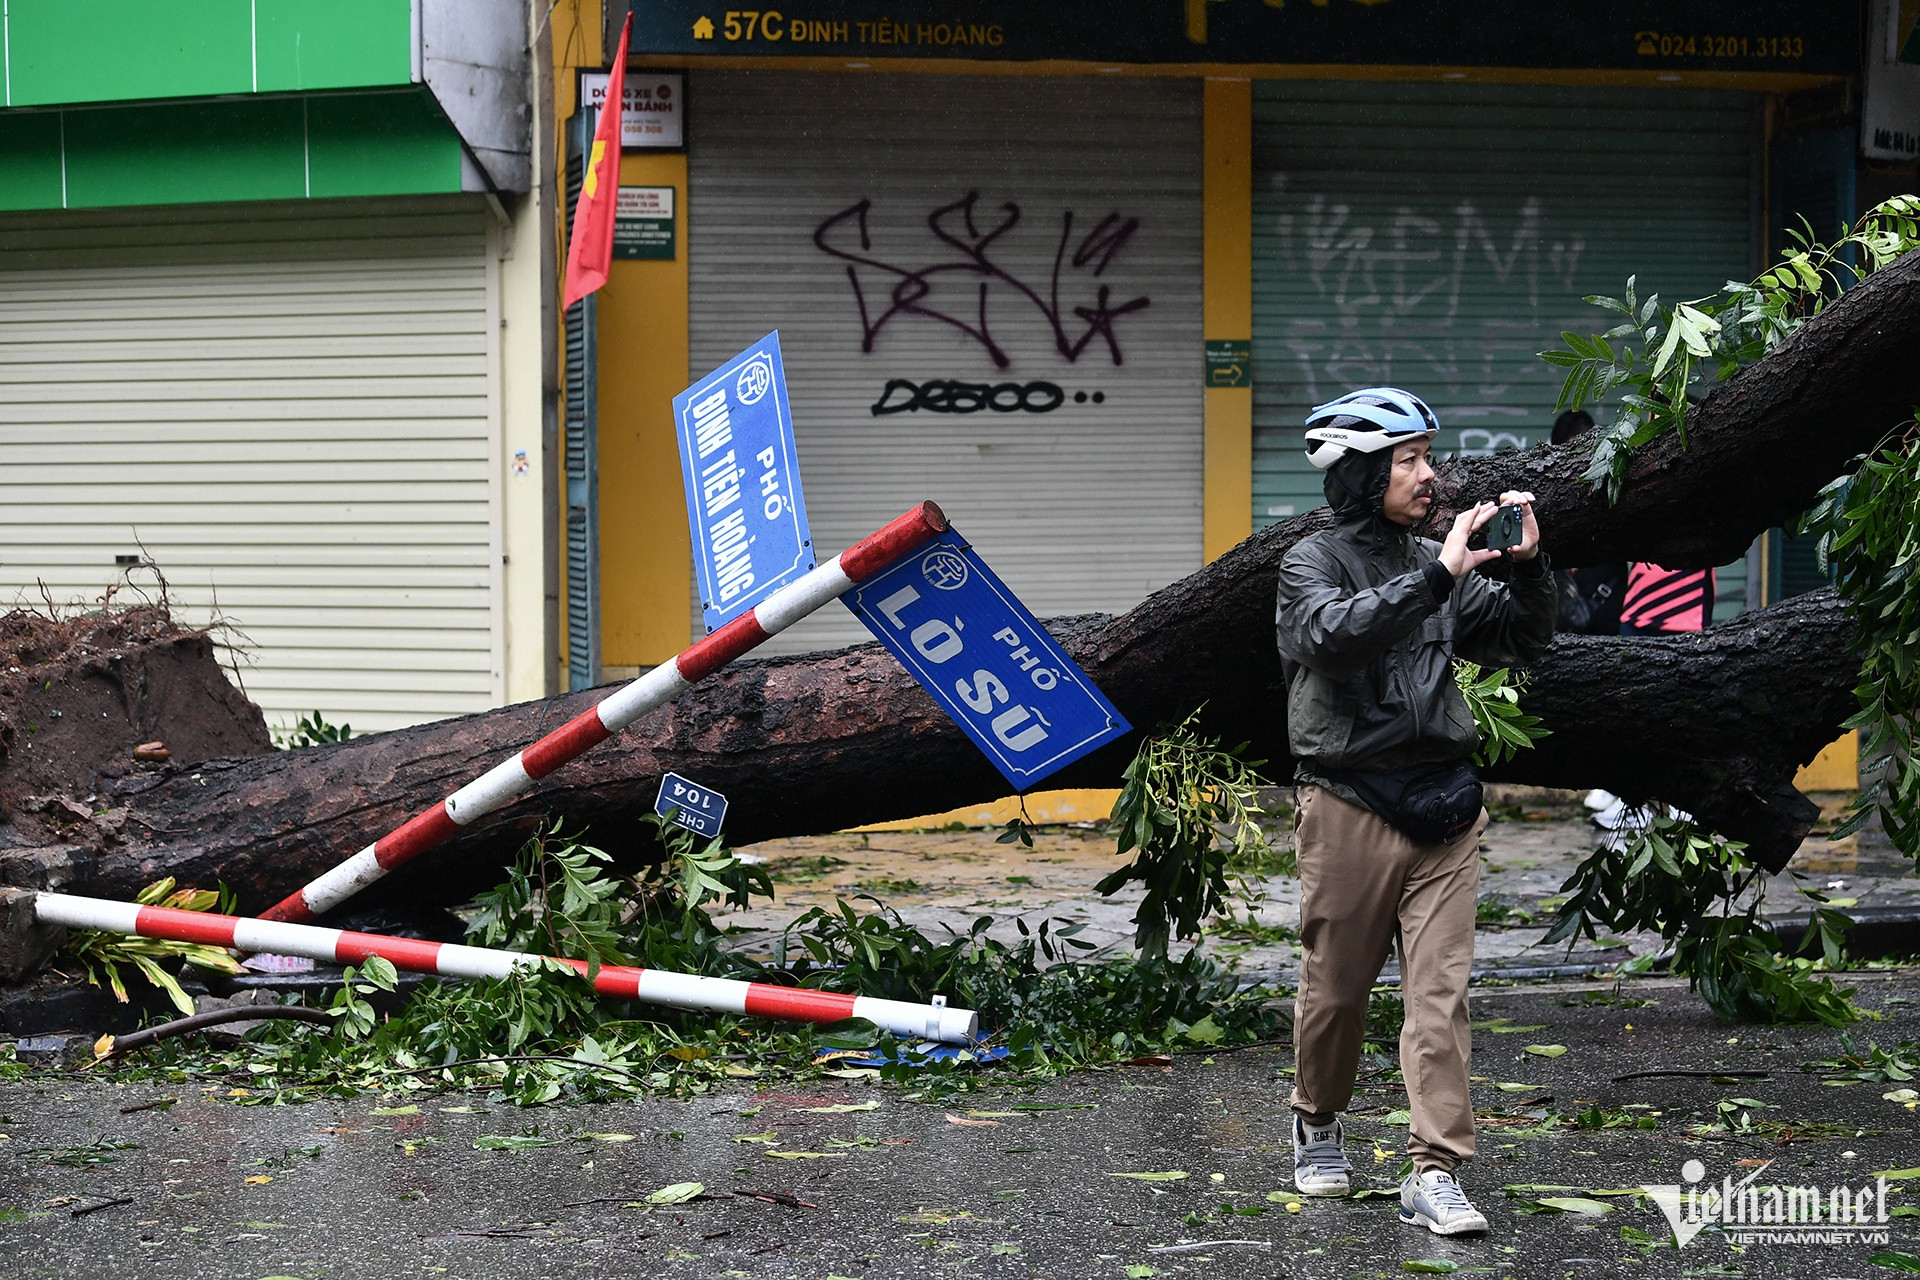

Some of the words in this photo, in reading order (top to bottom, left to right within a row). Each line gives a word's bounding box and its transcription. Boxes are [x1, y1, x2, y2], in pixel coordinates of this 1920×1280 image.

[724, 11, 783, 41] 57C
[790, 19, 848, 43] ĐINH
[857, 17, 909, 44] TIÊN
[916, 18, 1004, 46] HOÀNG
[1660, 35, 1803, 57] 024.3201.3133
[634, 100, 672, 112] BÁNH
[692, 388, 733, 459] ĐINH
[702, 448, 746, 518] TIÊN
[756, 446, 792, 520] PHỐ
[709, 507, 757, 602] HOÀNG
[876, 584, 965, 664] LÒ
[955, 669, 1051, 752] SŨ
[992, 626, 1072, 691] PHỐ
[673, 782, 711, 809] 104
